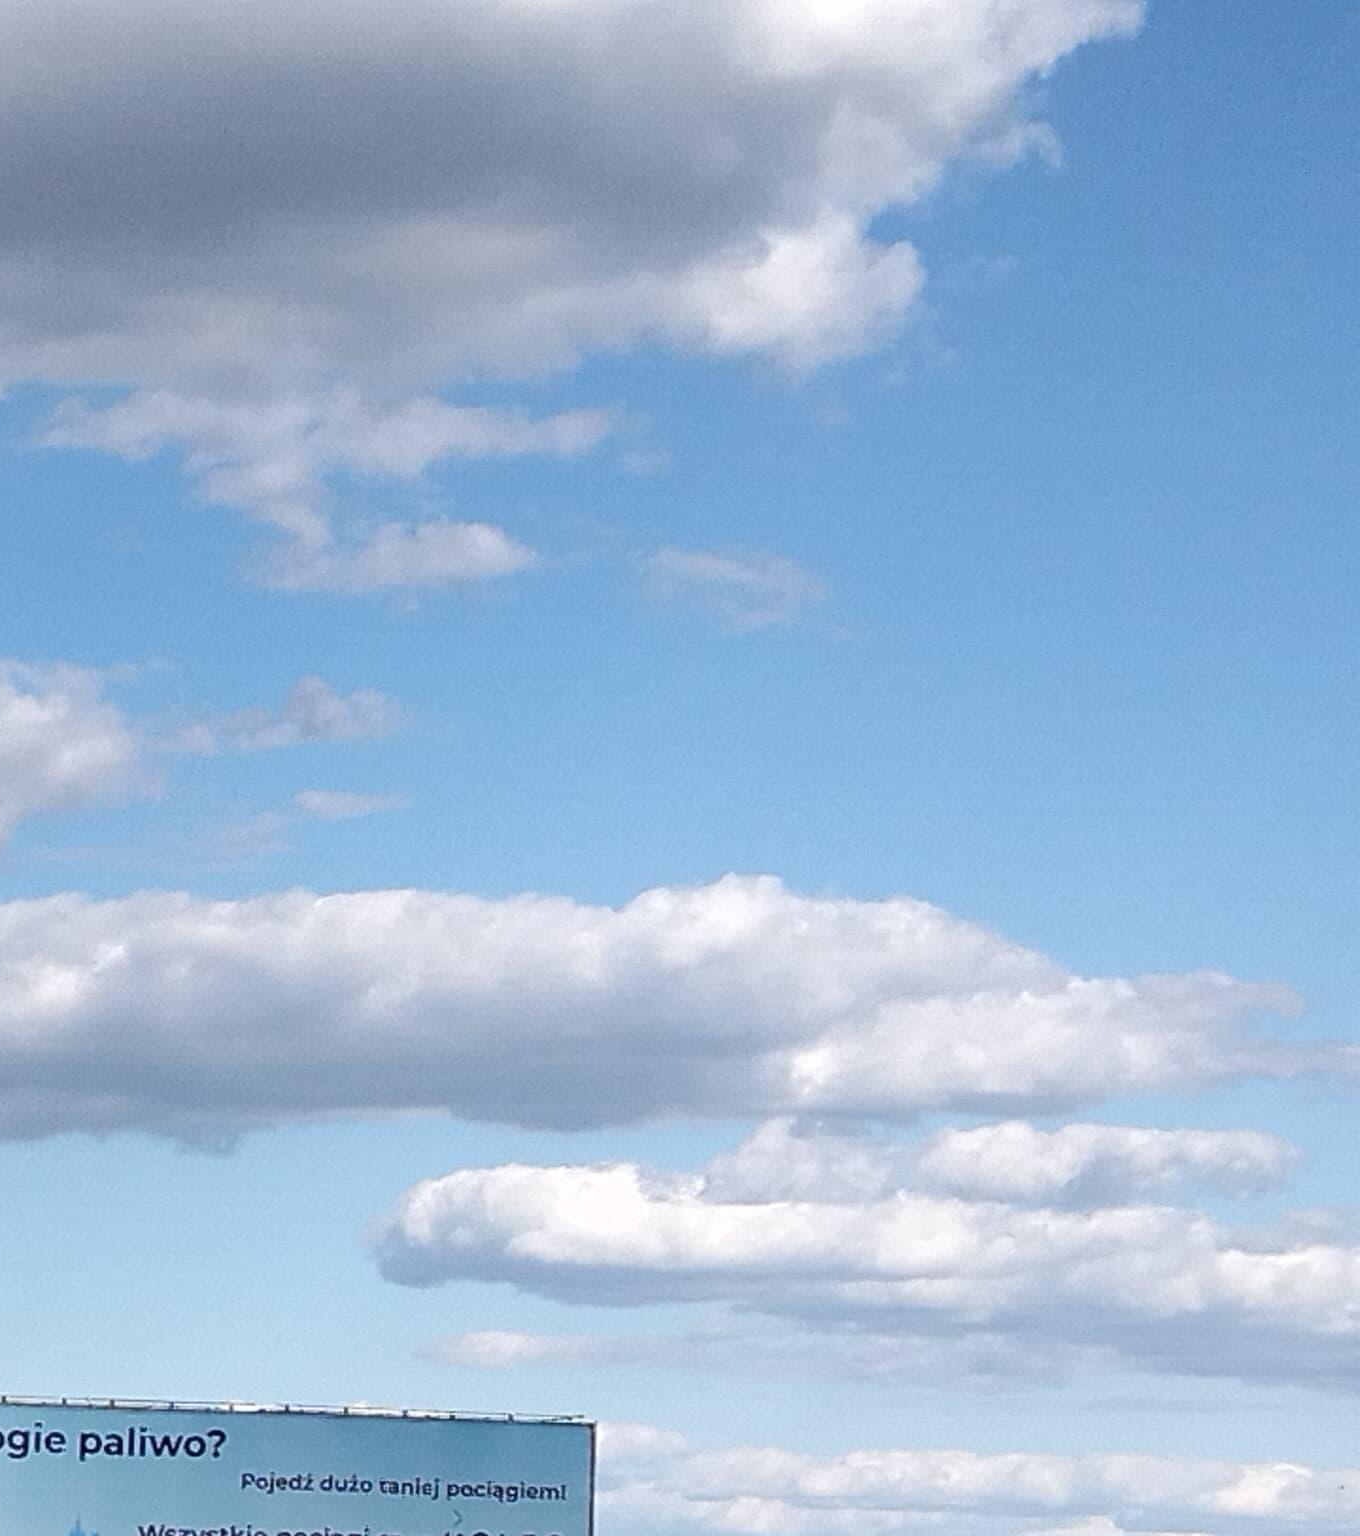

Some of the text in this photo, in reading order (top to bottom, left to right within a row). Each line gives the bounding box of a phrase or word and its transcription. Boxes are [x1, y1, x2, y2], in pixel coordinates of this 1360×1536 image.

[79, 1424, 227, 1462] paliwo?
[320, 1475, 373, 1493] dużo
[379, 1477, 440, 1500] taniej
[445, 1480, 566, 1503] pociągiem!
